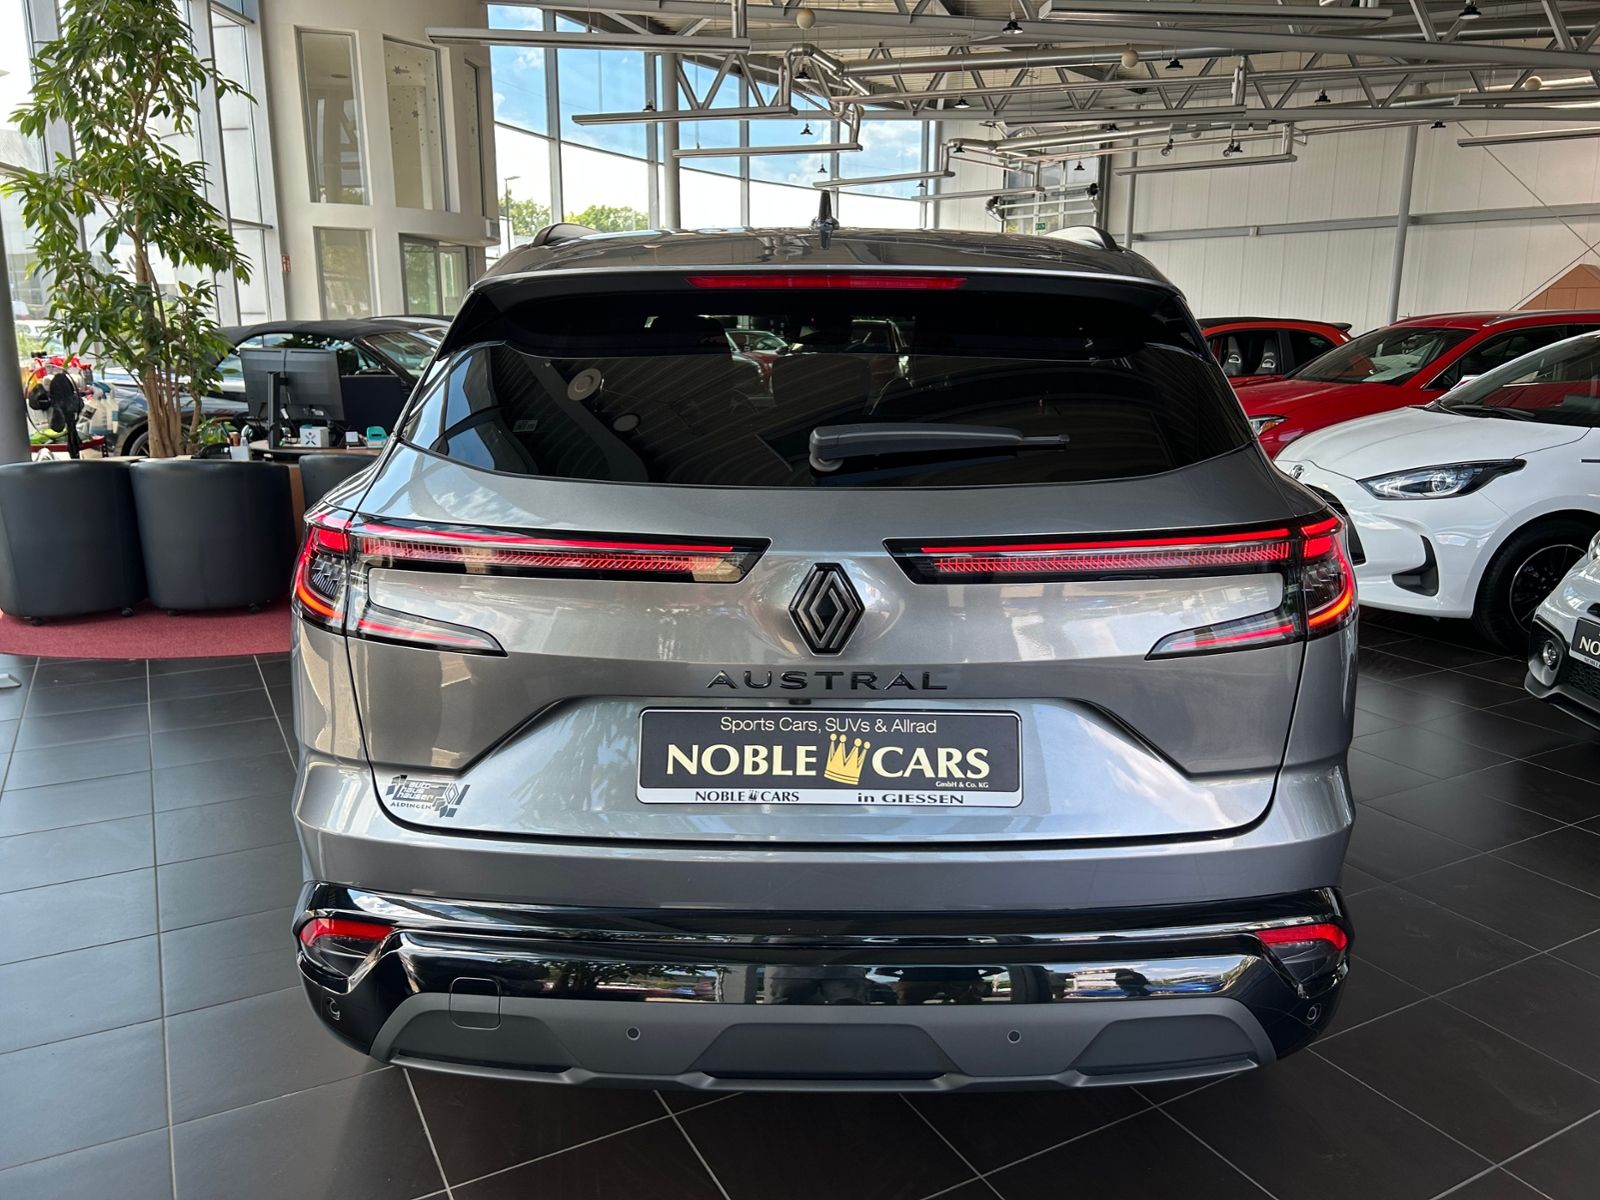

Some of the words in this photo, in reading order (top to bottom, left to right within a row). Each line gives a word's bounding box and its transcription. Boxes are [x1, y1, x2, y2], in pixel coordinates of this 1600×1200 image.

[706, 670, 947, 690] AUSTRAL
[720, 716, 775, 733] Sports
[779, 717, 821, 733] Cars,
[825, 717, 870, 732] SUVs
[874, 719, 887, 733] &
[891, 719, 937, 733] Allrad
[666, 744, 817, 776] NOBLE
[872, 746, 990, 779] CARS
[695, 791, 745, 802] NOBLE
[761, 791, 800, 802] CARS
[858, 793, 874, 802] in
[881, 794, 964, 804] GIESSEN
